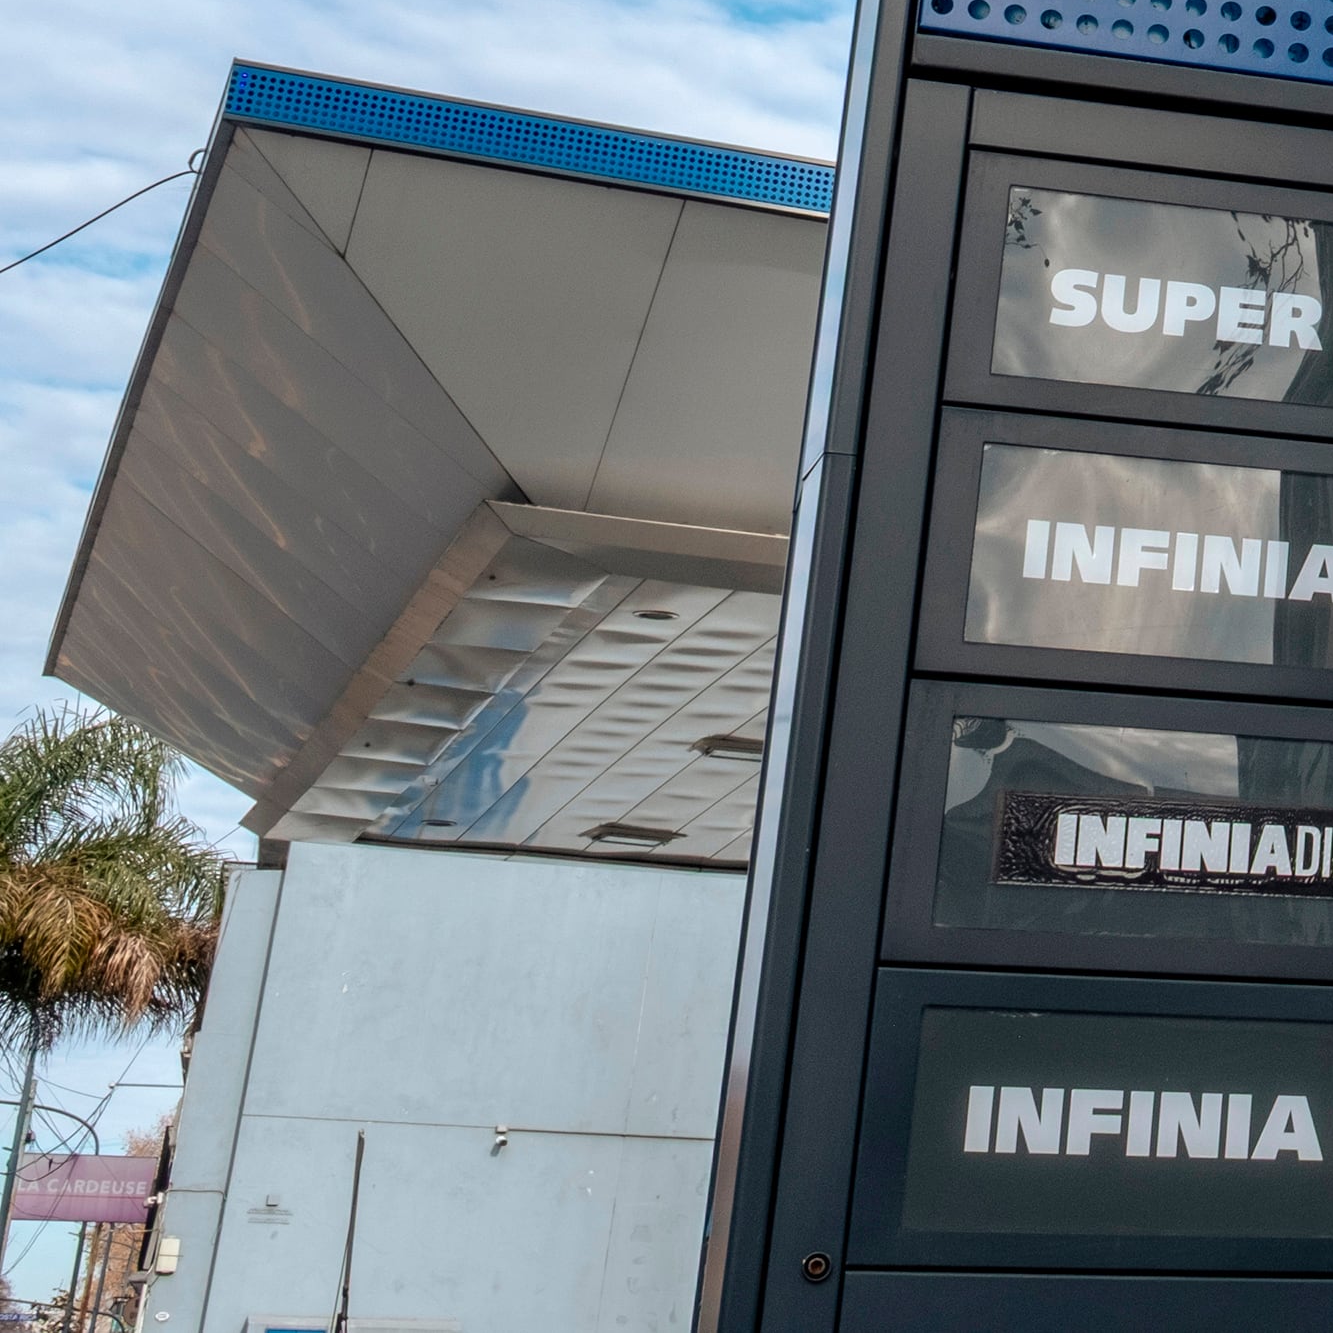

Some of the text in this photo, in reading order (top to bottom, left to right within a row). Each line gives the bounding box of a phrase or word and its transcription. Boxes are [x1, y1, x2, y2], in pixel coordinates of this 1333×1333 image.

[1049, 268, 1323, 351] SUPER
[961, 1084, 1325, 1162] INFINIA
[47, 1179, 147, 1194] CARDEUSE
